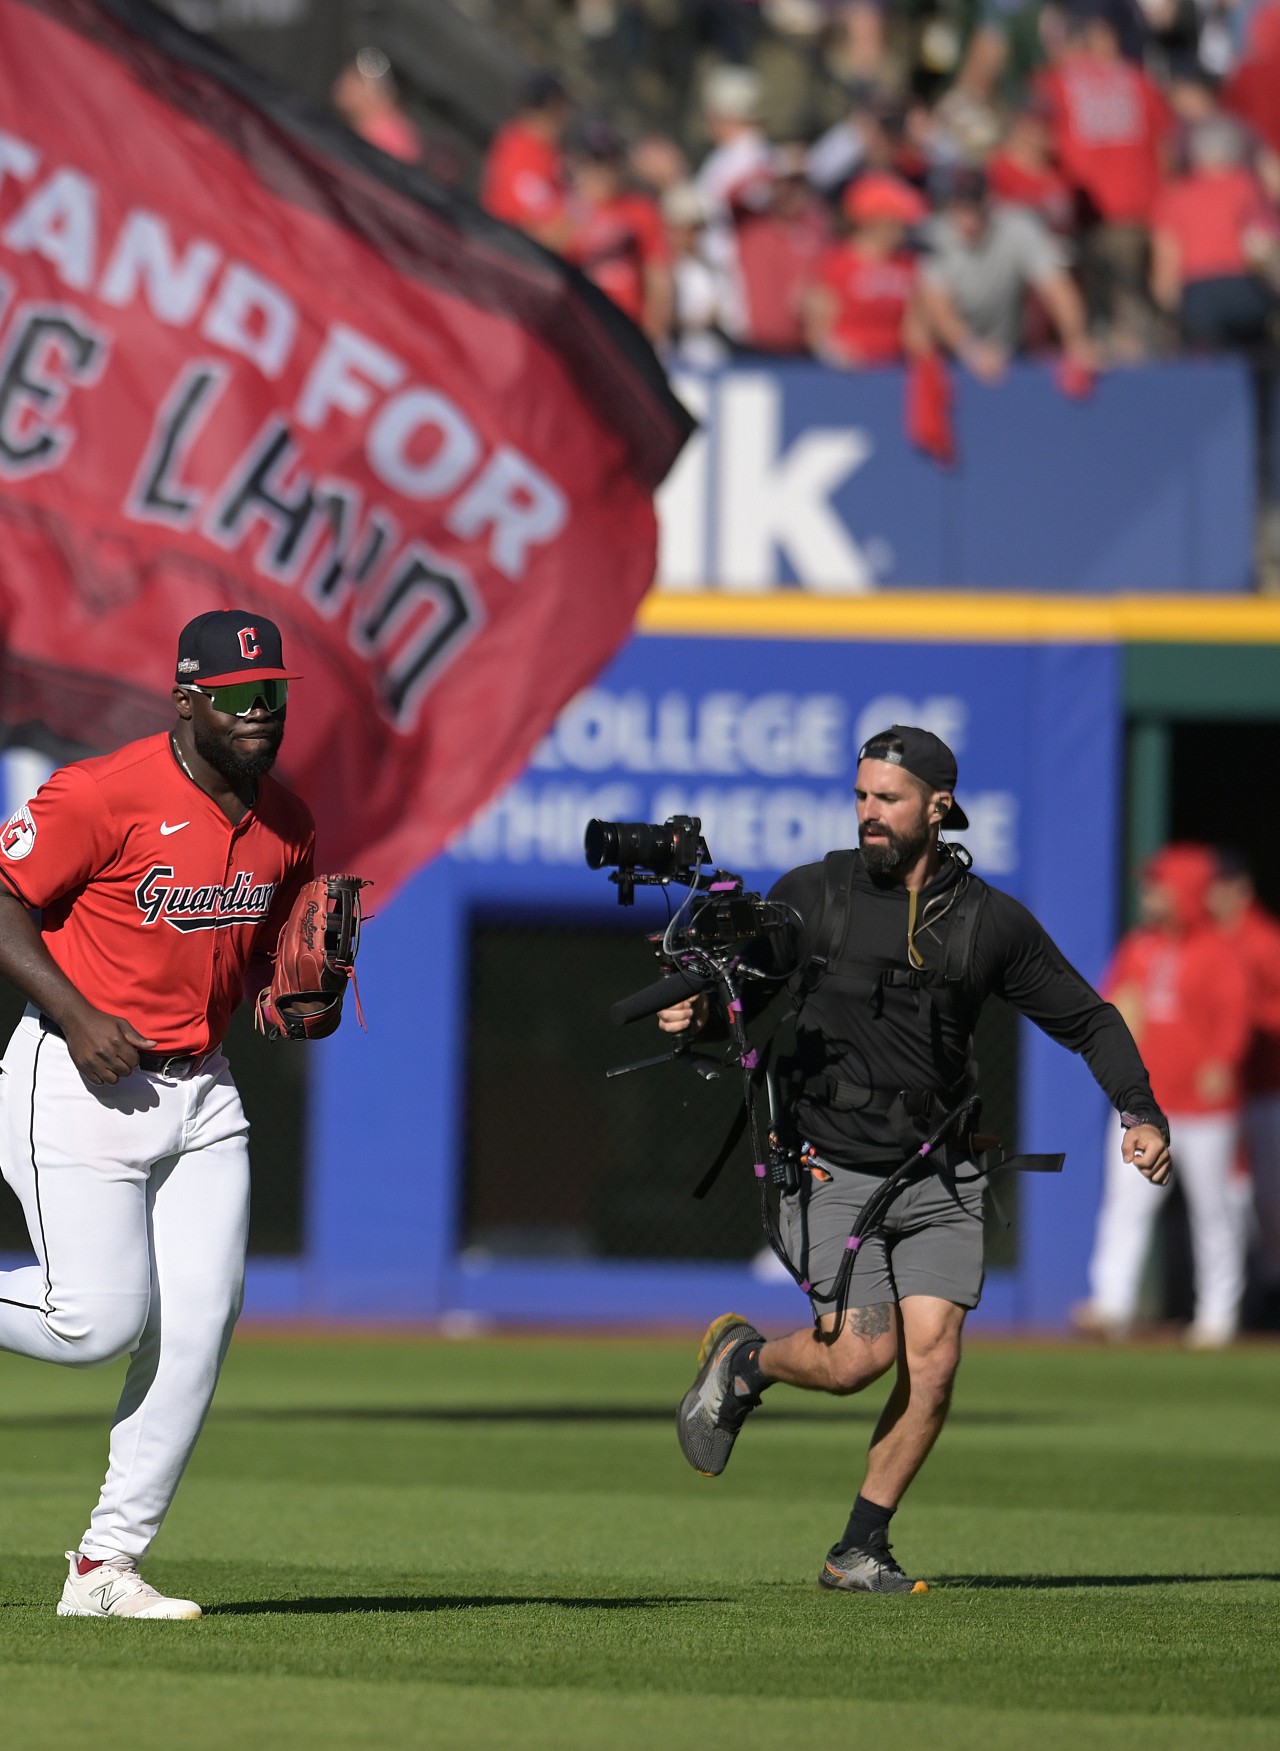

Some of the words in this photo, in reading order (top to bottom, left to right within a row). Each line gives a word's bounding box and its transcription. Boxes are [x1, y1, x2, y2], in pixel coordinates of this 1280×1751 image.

[294, 322, 570, 582] FOR
[530, 690, 848, 777] OLLEGE
[135, 866, 276, 926] Guardian
